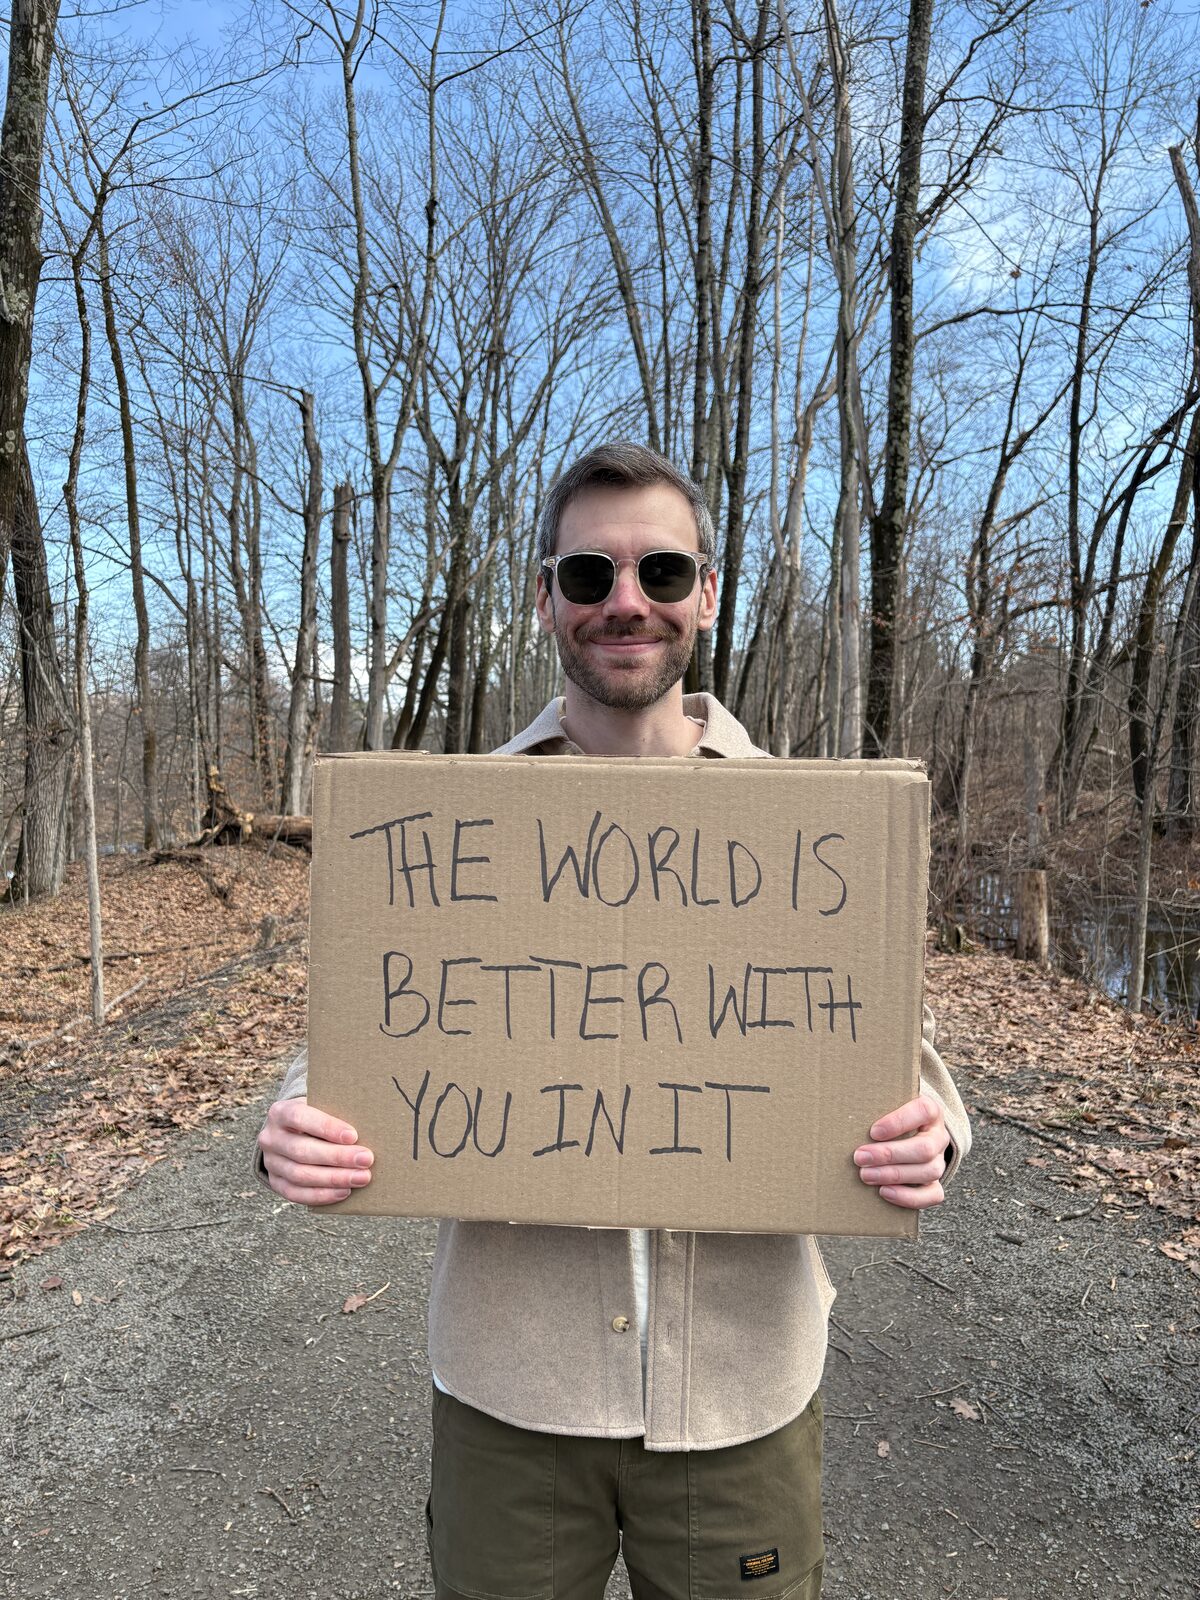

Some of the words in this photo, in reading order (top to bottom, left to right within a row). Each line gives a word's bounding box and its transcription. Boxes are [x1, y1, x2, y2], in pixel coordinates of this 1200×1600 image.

[350, 811, 499, 908] THE
[536, 810, 762, 908] WORLD
[792, 829, 847, 917] IS
[379, 950, 683, 1044] BETTER
[708, 962, 863, 1043] WITH
[391, 1069, 512, 1161] YOU
[532, 1084, 631, 1158] IN
[648, 1081, 771, 1163] IT
